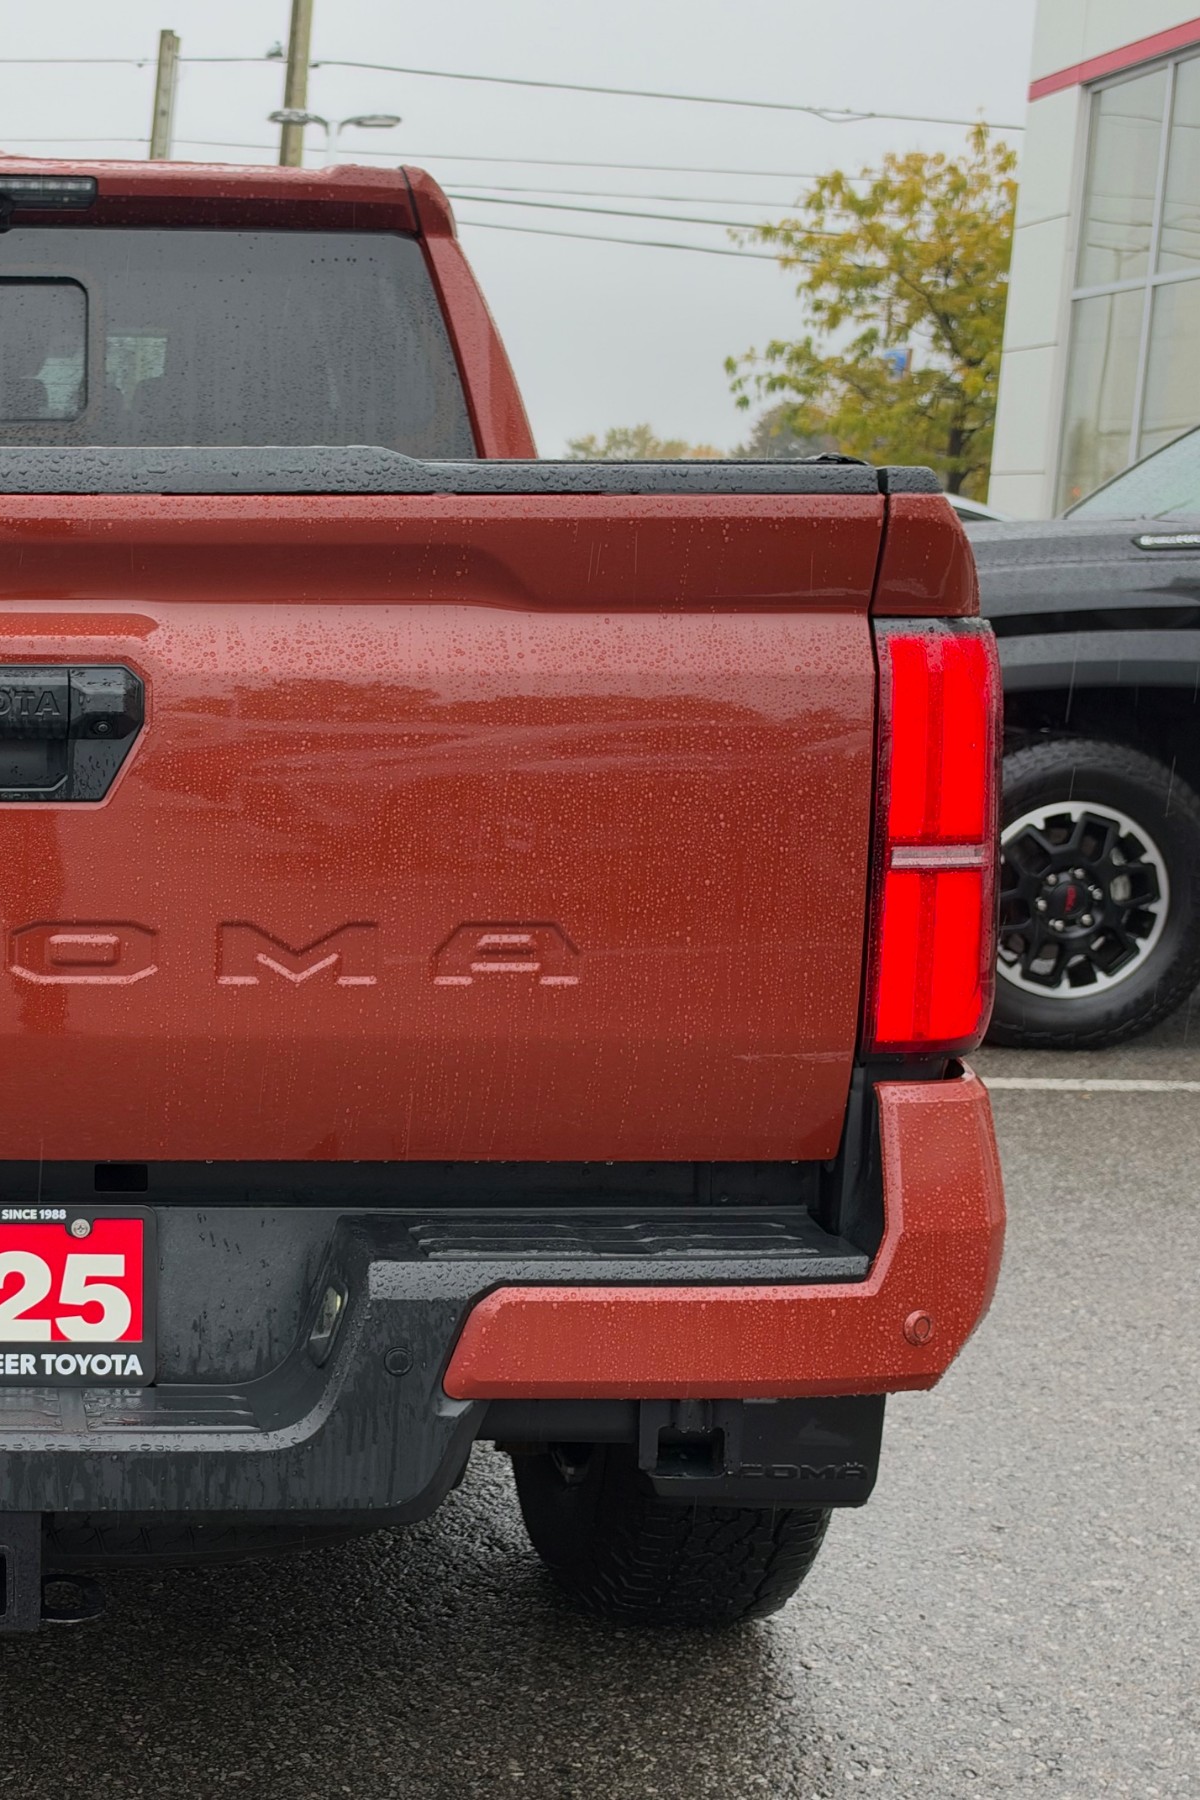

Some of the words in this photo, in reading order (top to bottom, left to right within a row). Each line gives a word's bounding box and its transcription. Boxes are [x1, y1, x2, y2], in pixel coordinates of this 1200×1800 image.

[2, 1208, 38, 1221] SINCE
[39, 1208, 67, 1221] 1988
[40, 1353, 143, 1376] TOYOTA
